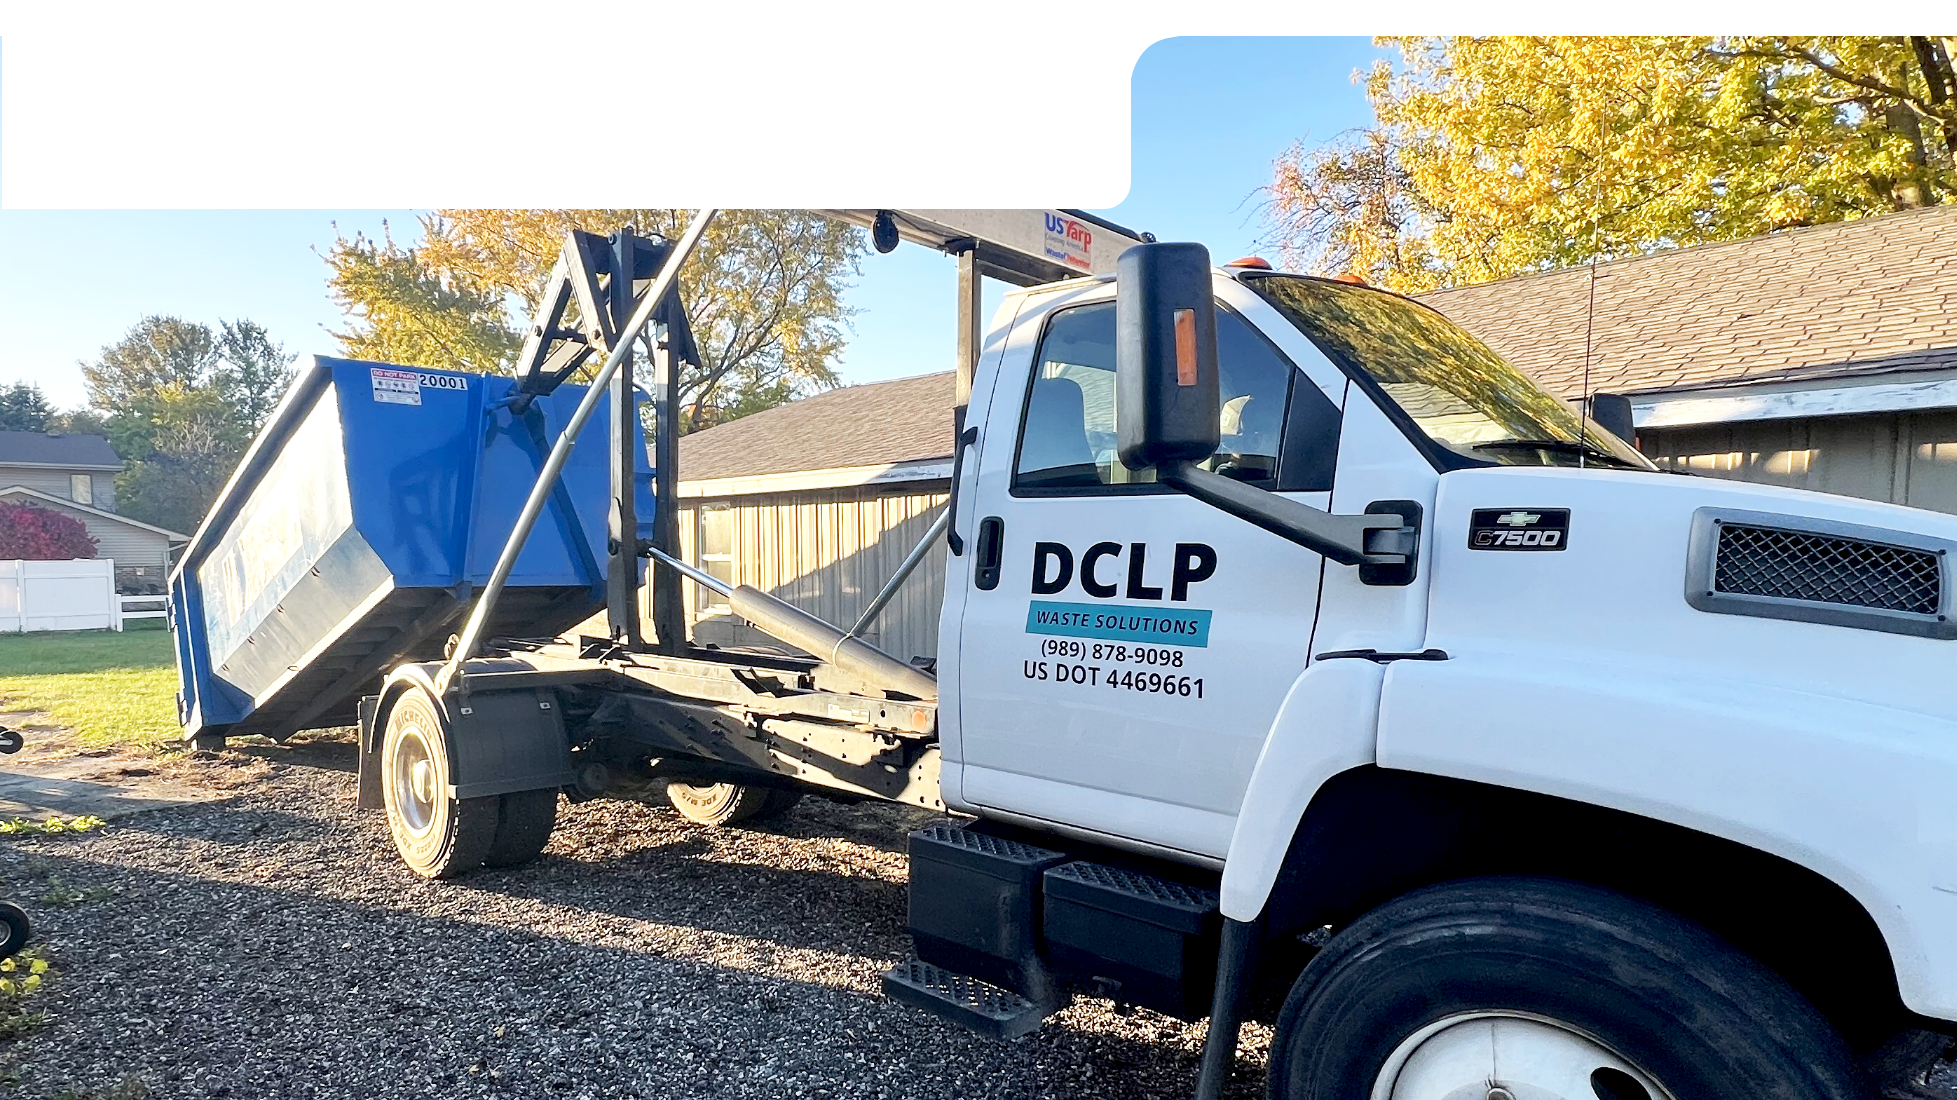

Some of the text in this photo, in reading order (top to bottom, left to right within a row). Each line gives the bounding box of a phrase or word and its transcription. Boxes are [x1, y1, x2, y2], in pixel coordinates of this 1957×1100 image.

[1044, 212, 1092, 253] US Tarp
[384, 371, 398, 379] NOT
[399, 372, 416, 380] PARK
[419, 374, 465, 389] 20001
[1474, 529, 1561, 546] C7500
[1031, 541, 1218, 602] DCLP
[1037, 610, 1199, 636] WASTE SOLUTIONS
[1041, 638, 1184, 668] (989) 878-9098
[1023, 659, 1205, 699] US DOT 4469661
[394, 710, 432, 741] MICHELIN
